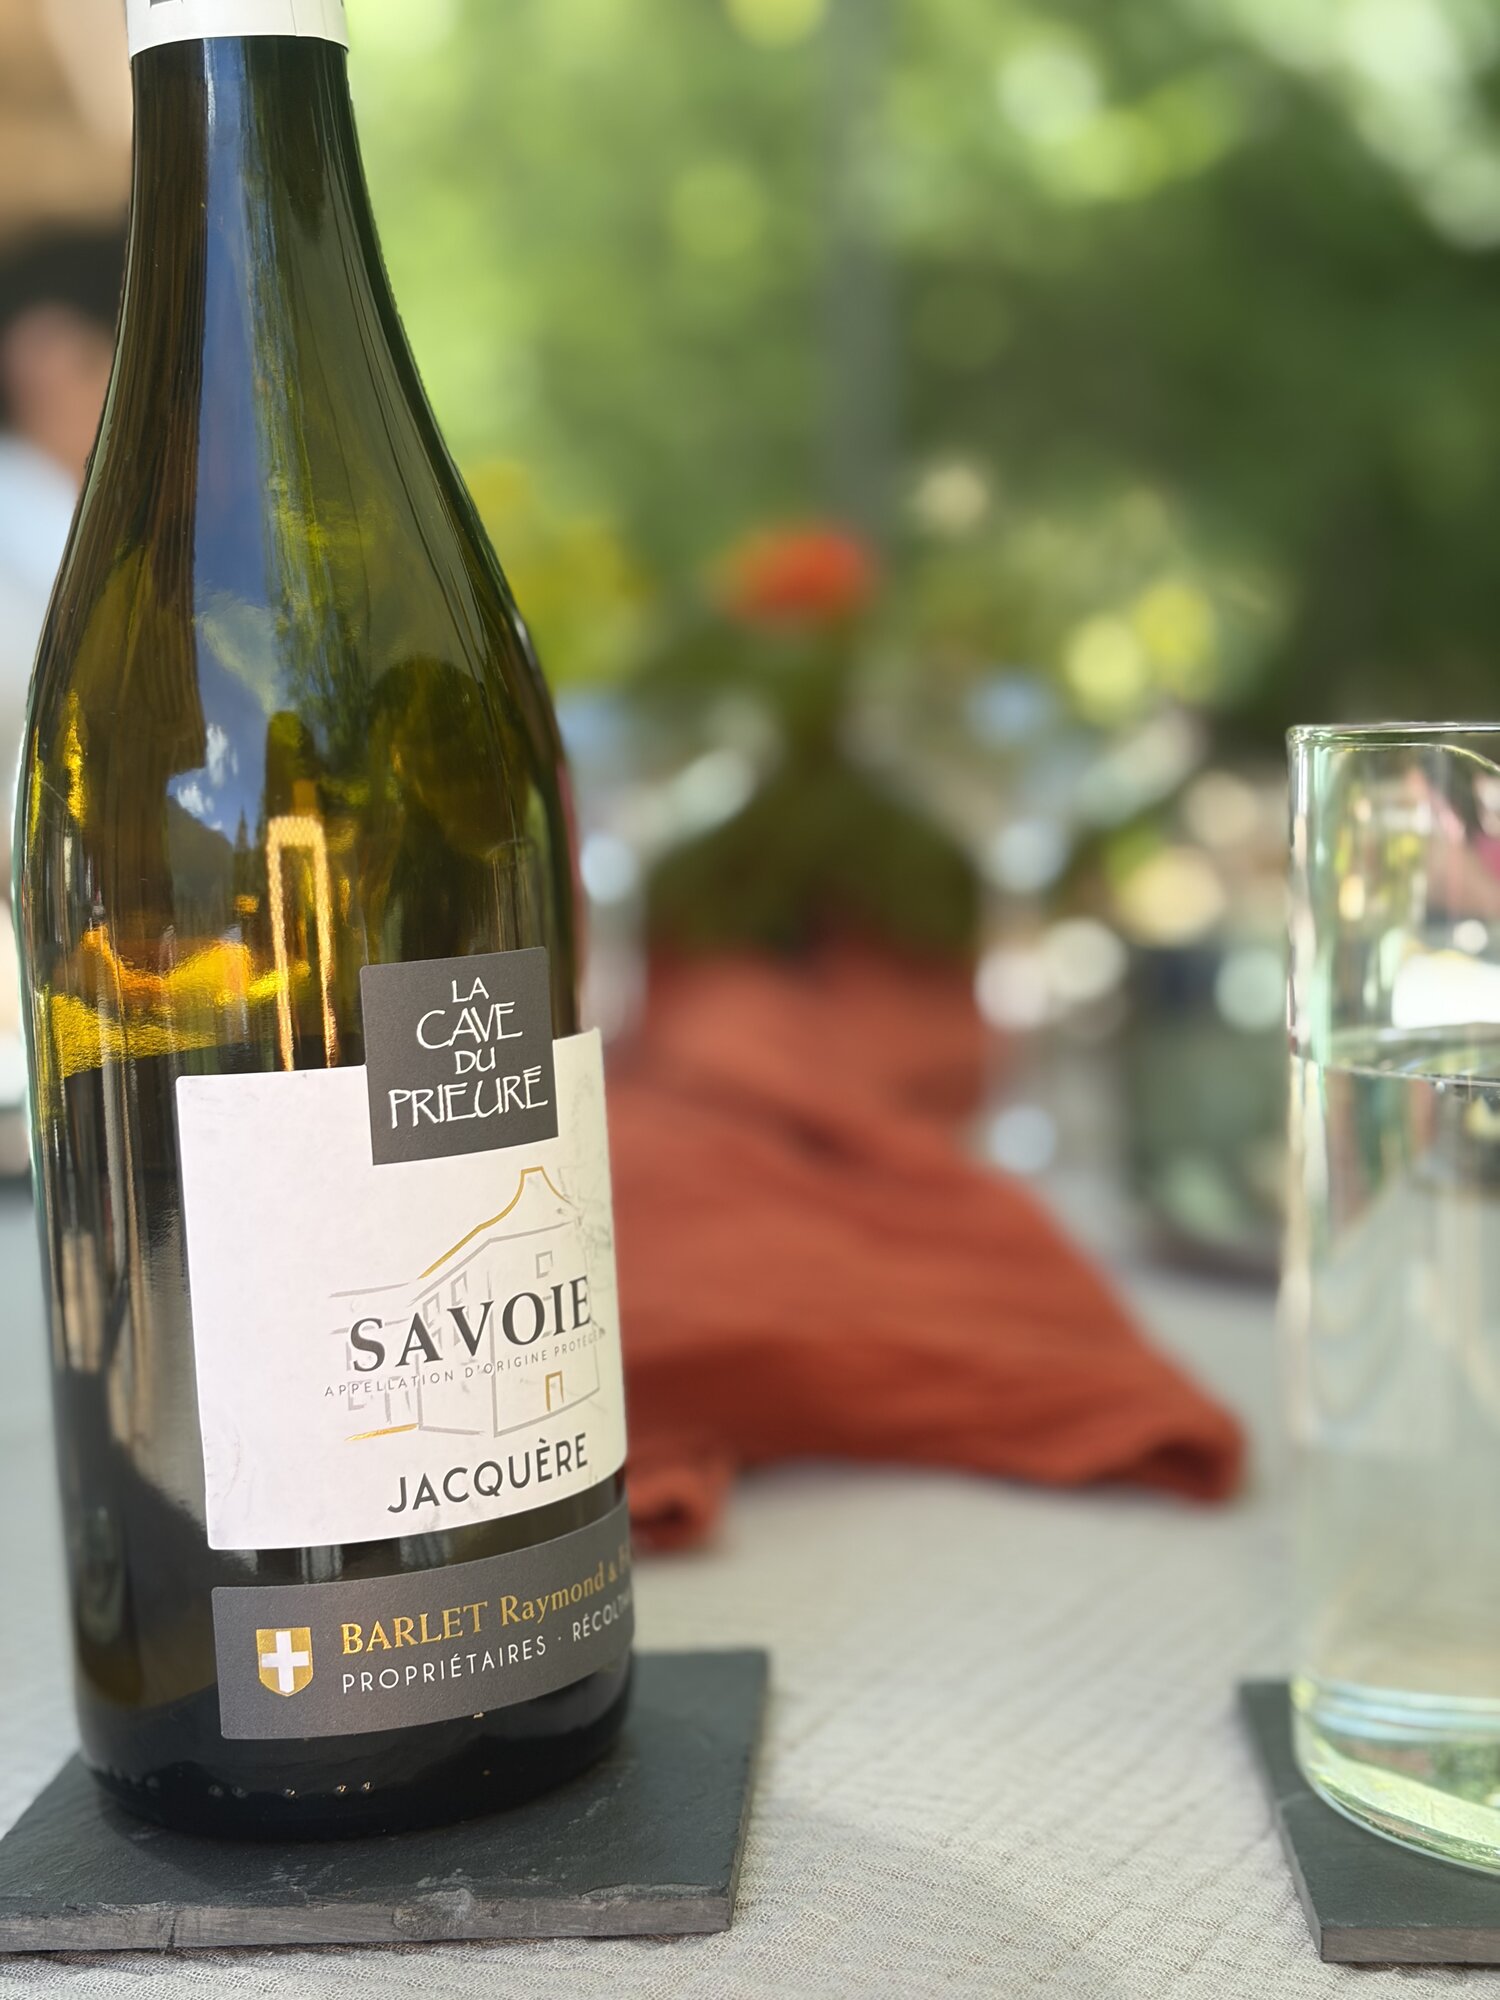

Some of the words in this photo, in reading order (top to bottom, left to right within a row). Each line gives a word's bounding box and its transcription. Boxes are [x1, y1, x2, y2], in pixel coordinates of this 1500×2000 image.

[451, 976, 490, 1003] LA
[416, 1001, 523, 1050] CAVE
[454, 1046, 497, 1075] DU
[387, 1065, 549, 1130] PRIEURÉ
[349, 1275, 592, 1373] SAVOIE
[324, 1369, 455, 1398] APPELLATION
[464, 1350, 549, 1379] D'ORIGINE
[387, 1432, 589, 1514] JACQUÈRE
[340, 1600, 489, 1656] BARLET
[500, 1560, 605, 1627] Raymond
[342, 1634, 548, 1695] PROPRIÉTAIRES
